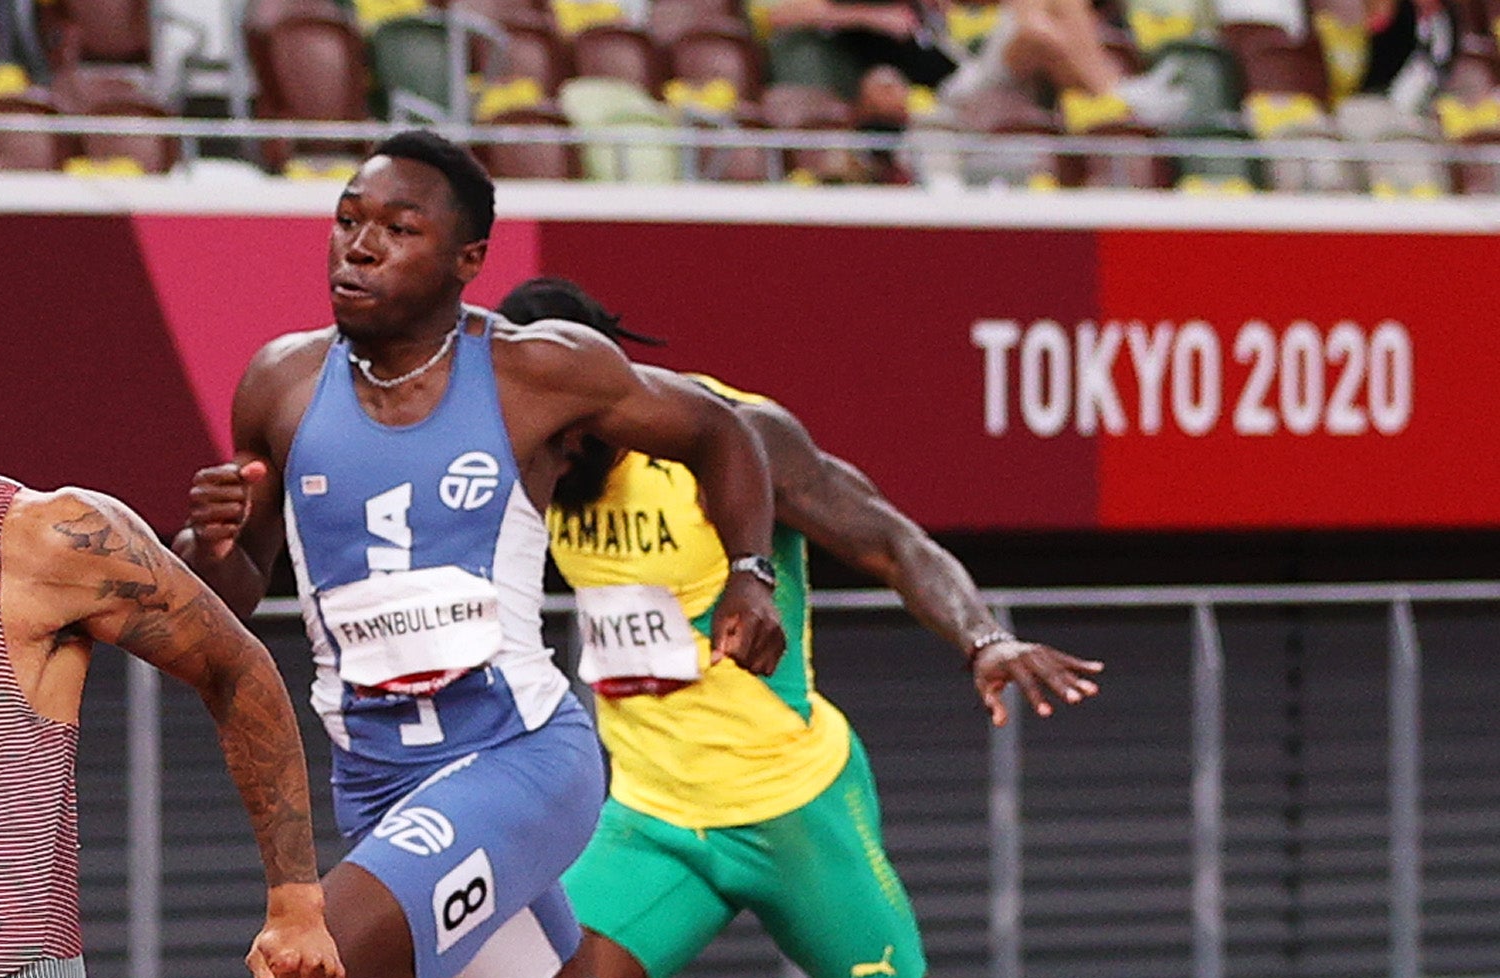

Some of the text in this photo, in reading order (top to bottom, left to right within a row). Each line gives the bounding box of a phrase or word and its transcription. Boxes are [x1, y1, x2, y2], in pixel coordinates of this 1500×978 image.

[969, 318, 1415, 438] TOKYO 2020
[550, 505, 679, 553] AMAICA
[340, 601, 484, 644] FAHNBULLEH
[443, 877, 487, 931] 8
